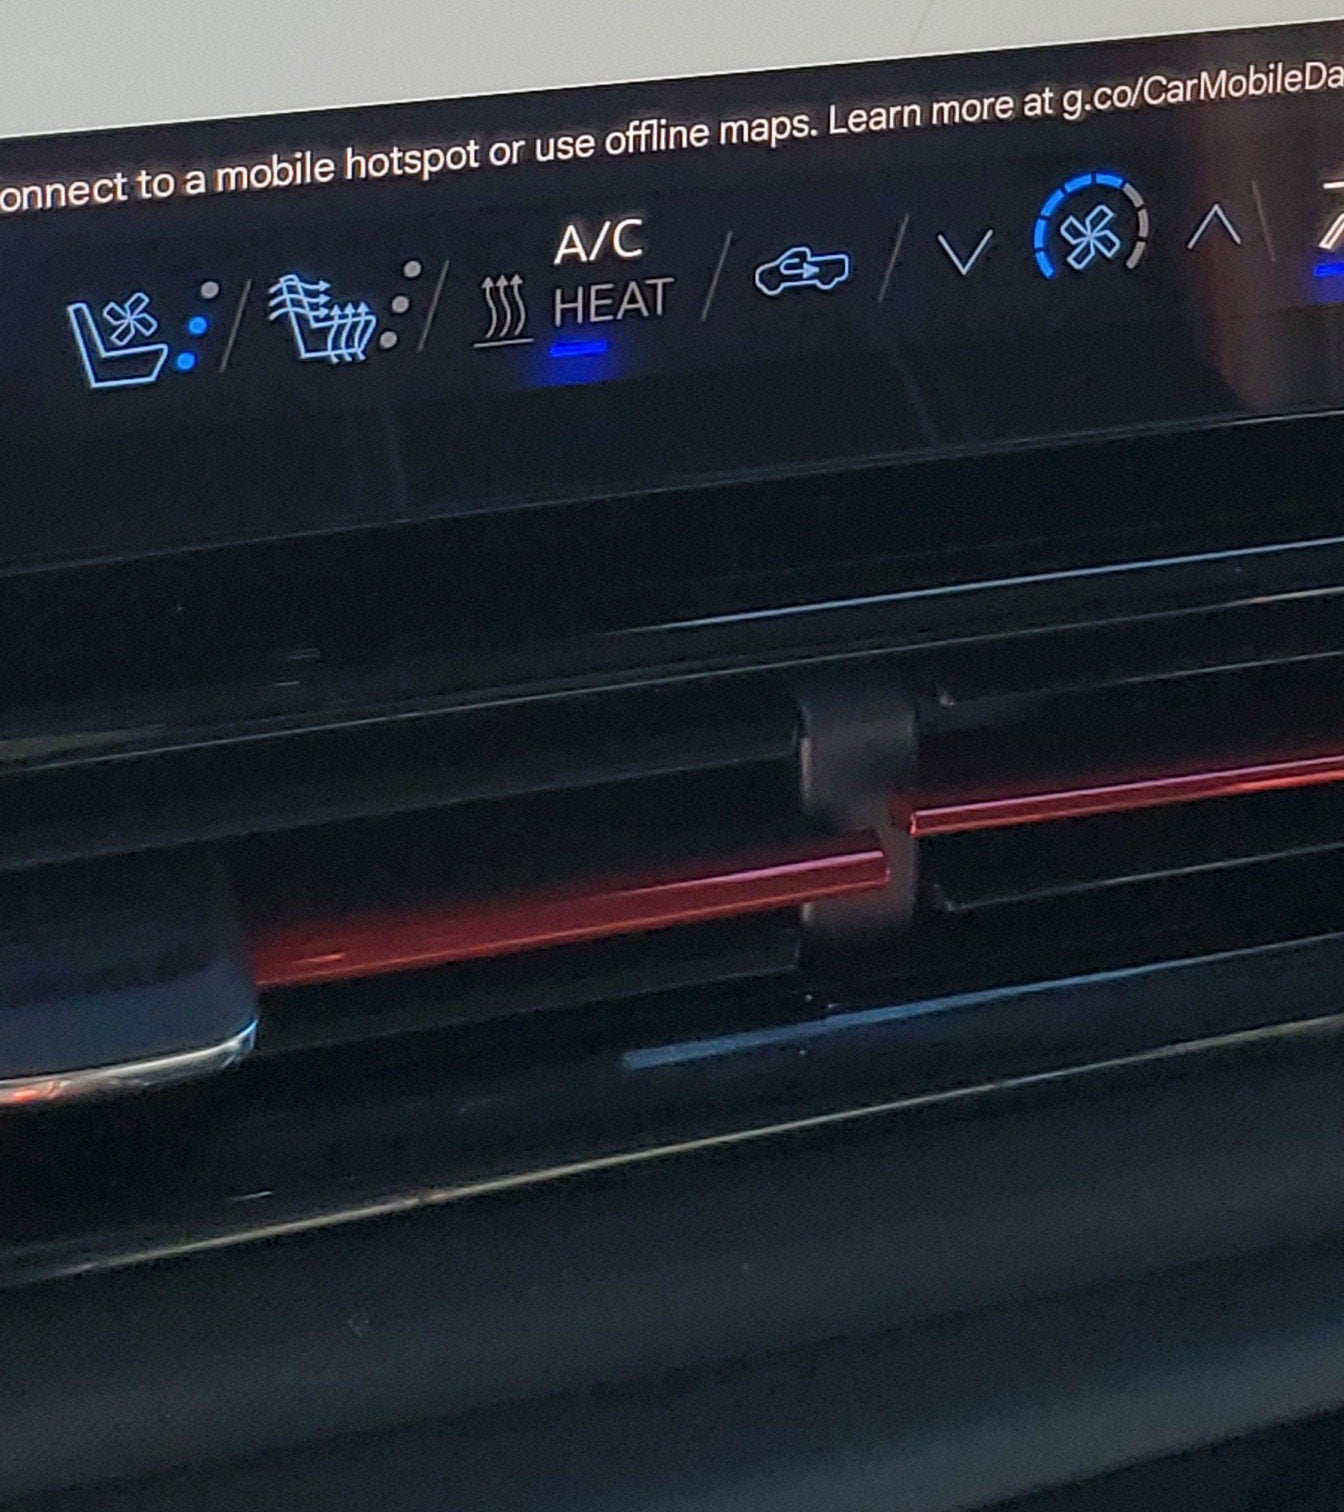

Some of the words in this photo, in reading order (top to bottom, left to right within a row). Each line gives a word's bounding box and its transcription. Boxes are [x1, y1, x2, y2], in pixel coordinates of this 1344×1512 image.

[135, 167, 176, 201] to
[183, 169, 207, 196] a
[214, 149, 337, 192] mobile
[344, 138, 481, 182] hotspot
[487, 138, 527, 168] or
[534, 132, 597, 163] use
[604, 116, 711, 156] offline
[718, 114, 819, 149] maps.
[828, 100, 923, 135] Learn
[930, 94, 1016, 126] more
[1022, 86, 1055, 118] at
[552, 217, 644, 266] A/C
[552, 276, 675, 328] HEAT
